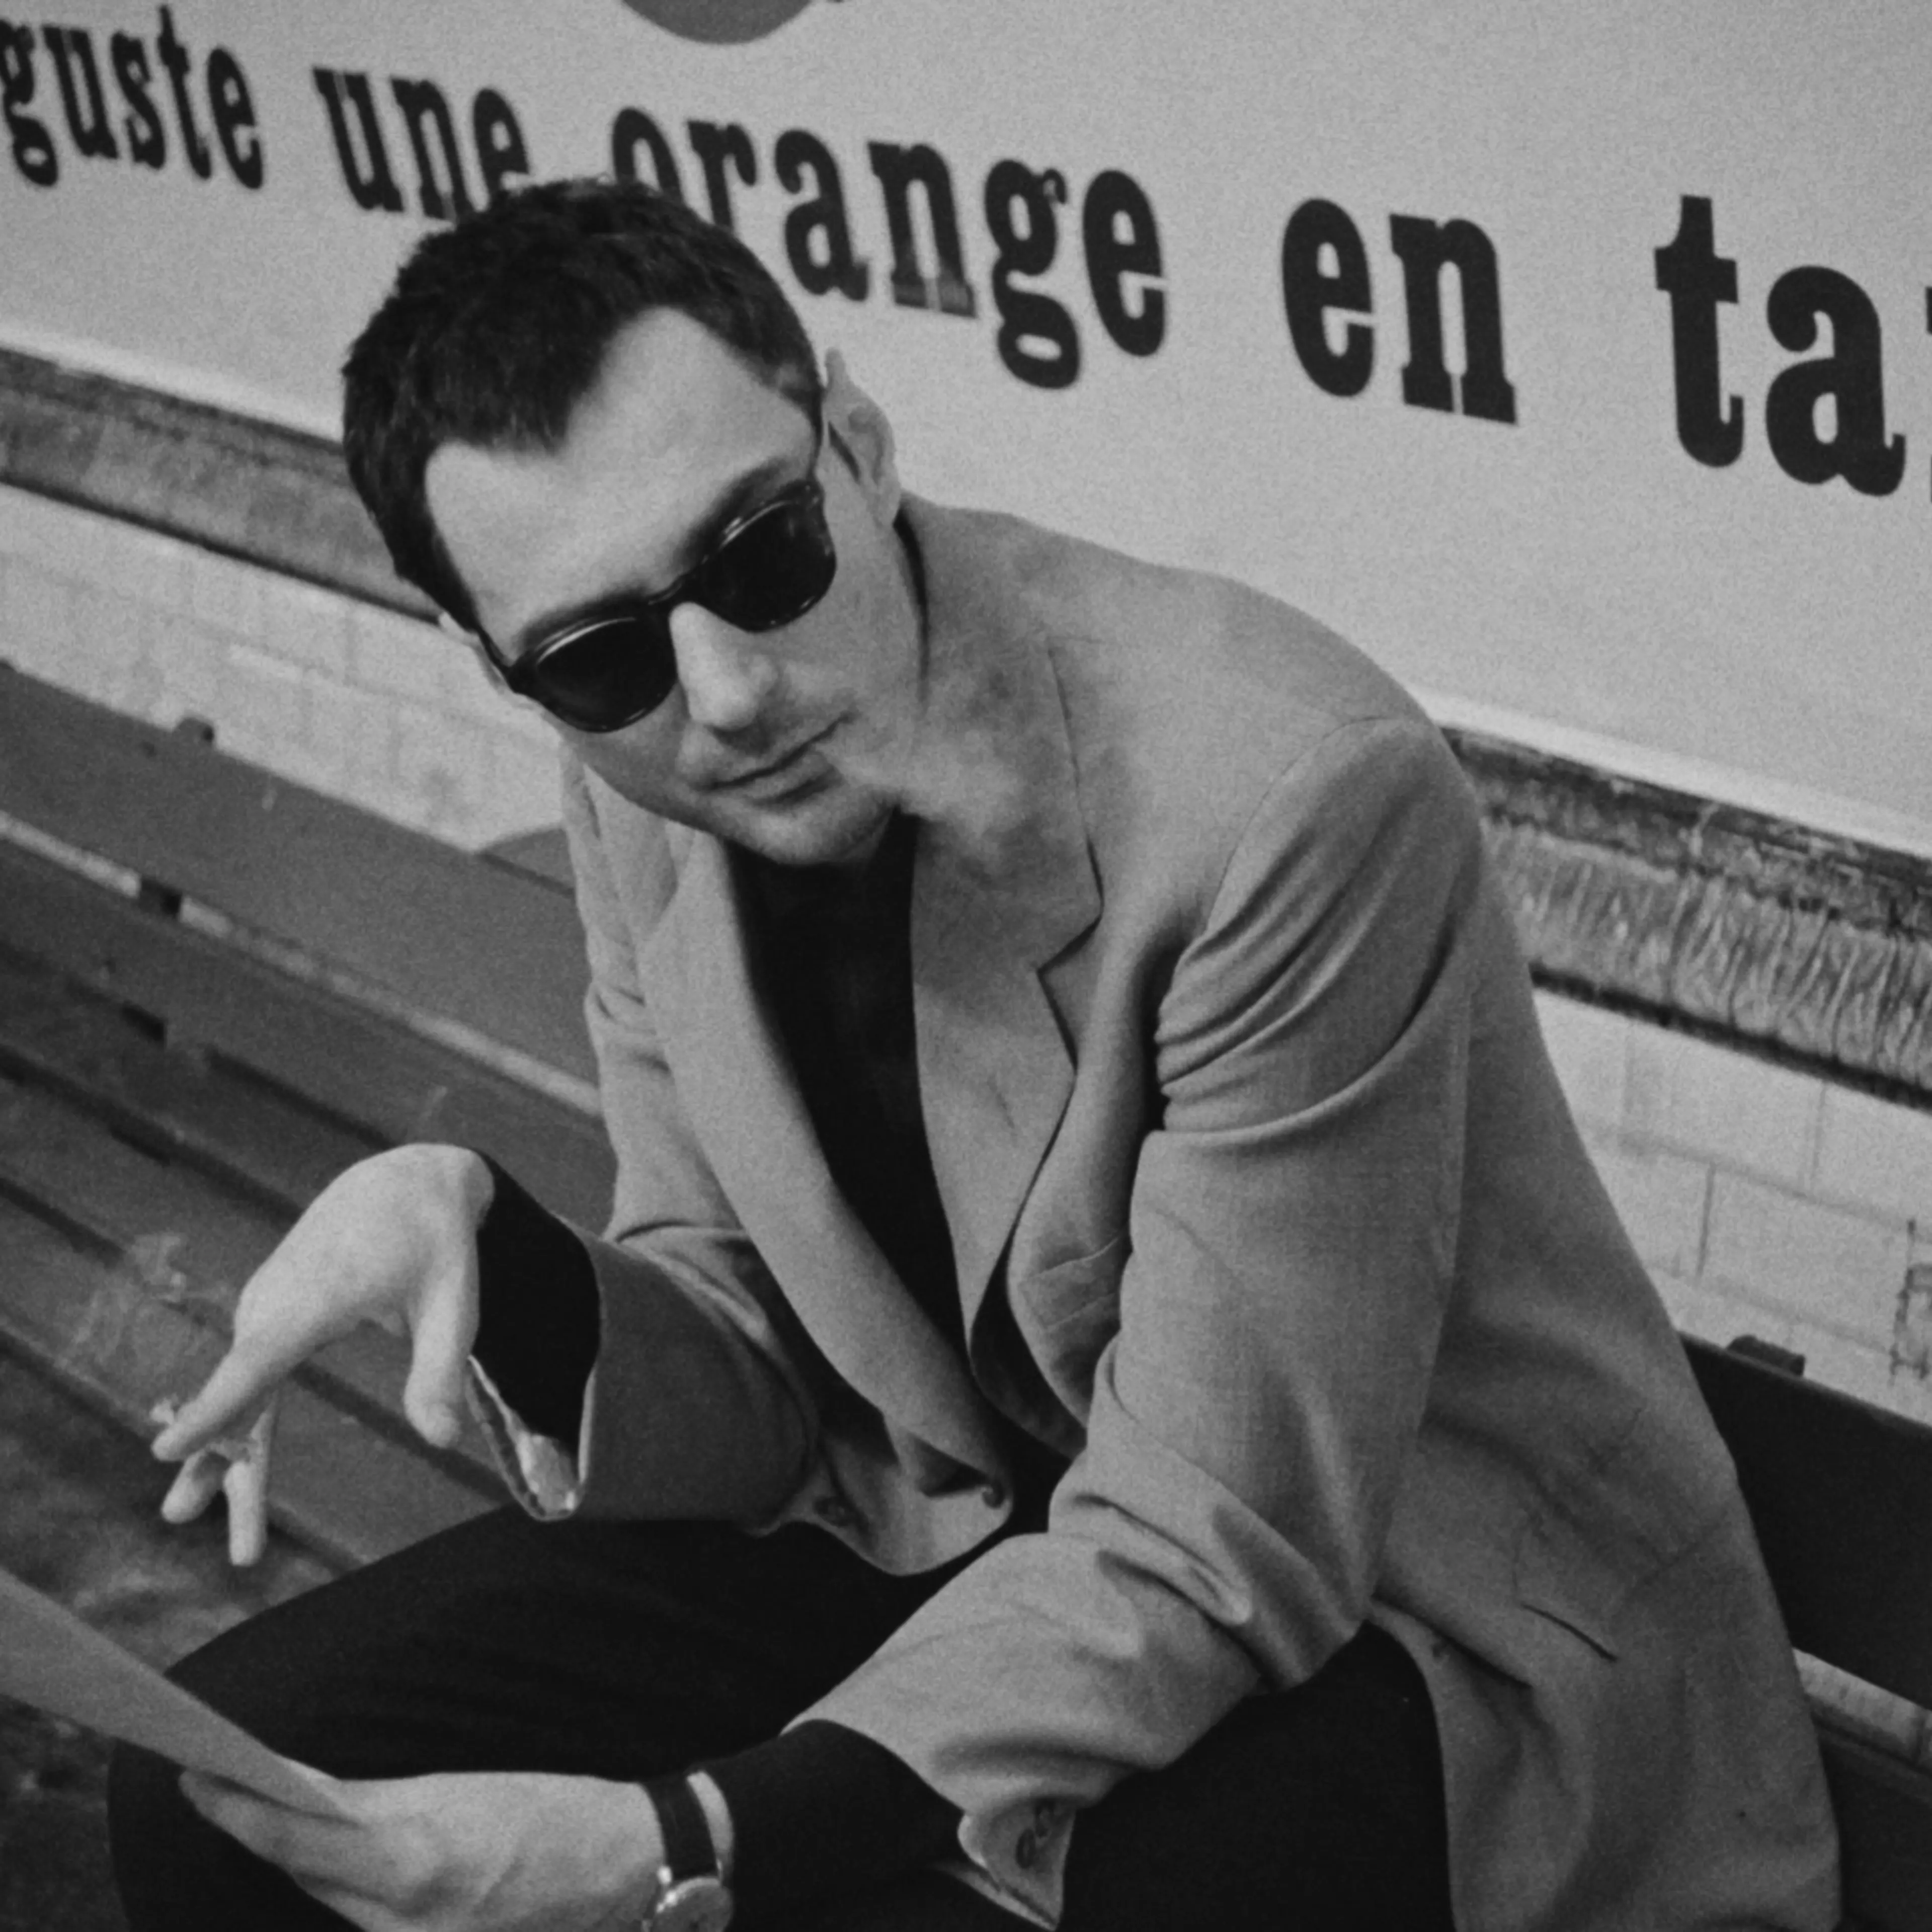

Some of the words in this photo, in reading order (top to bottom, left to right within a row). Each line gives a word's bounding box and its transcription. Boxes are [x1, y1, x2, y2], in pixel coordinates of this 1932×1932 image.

[312, 66, 529, 222] une
[1281, 198, 1517, 424] en
[1654, 195, 1932, 504] ta
